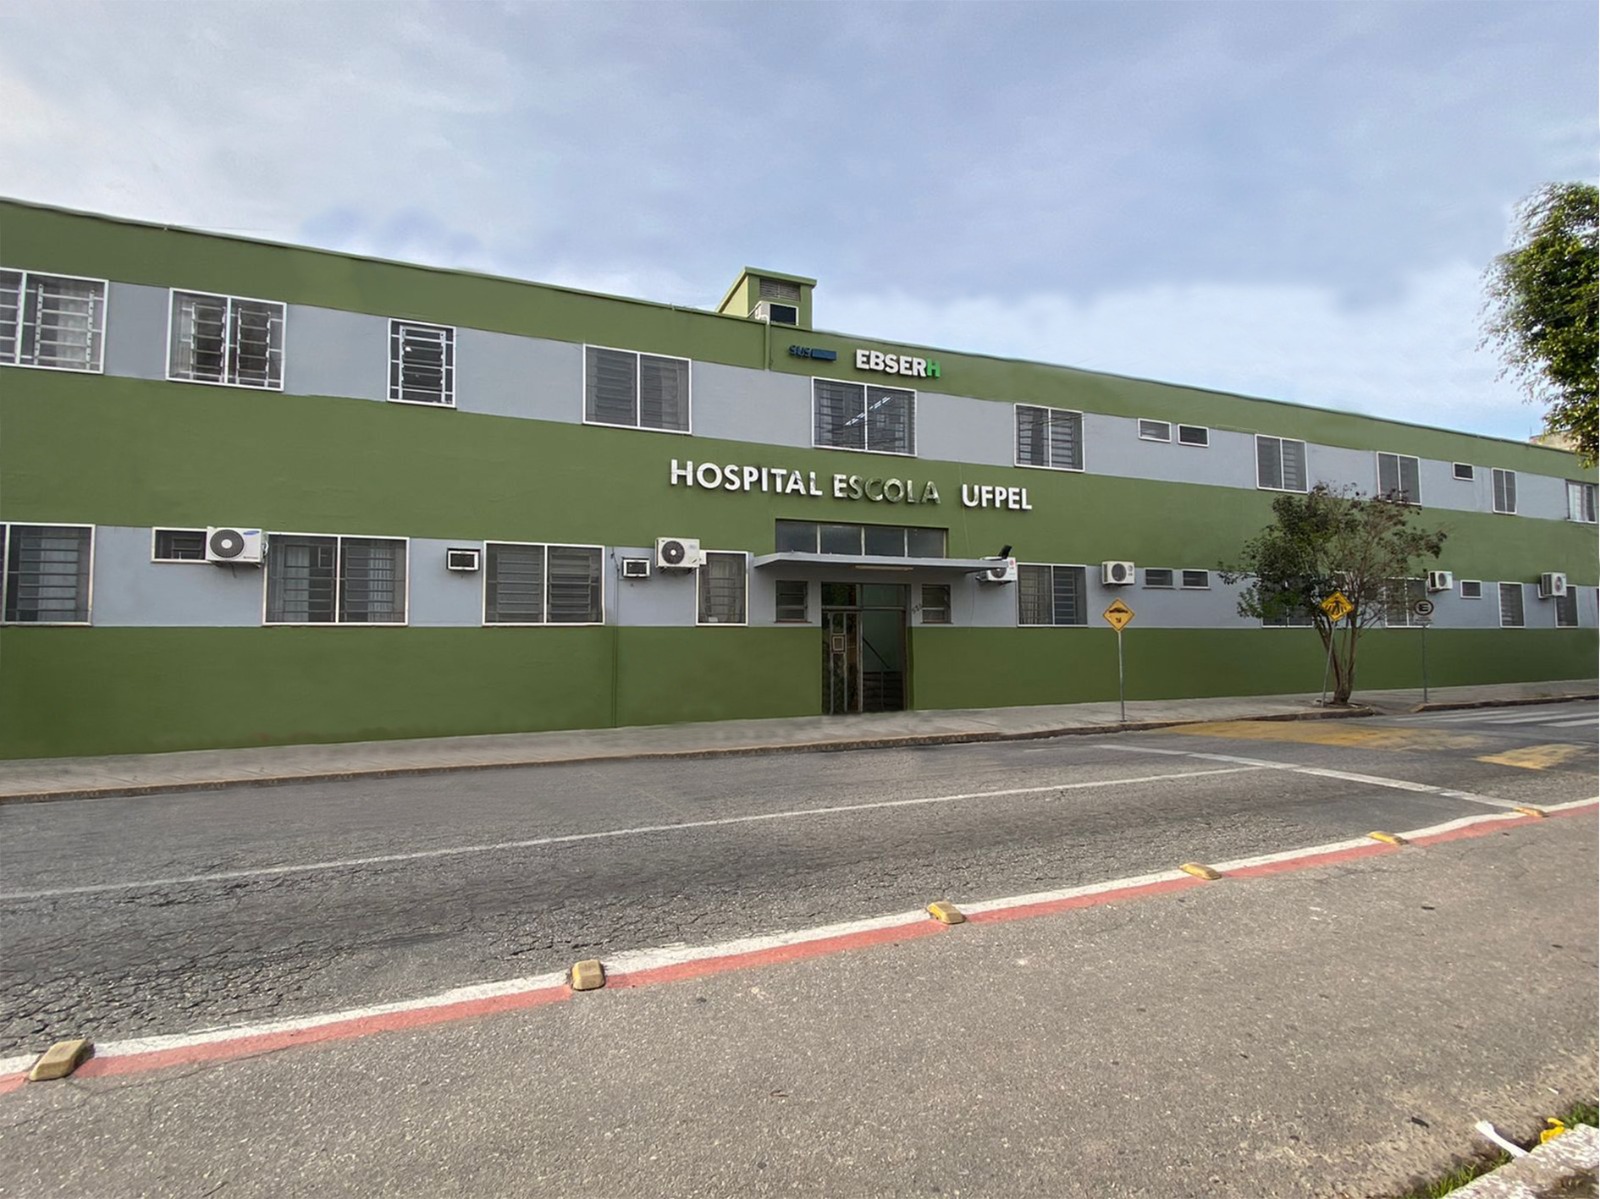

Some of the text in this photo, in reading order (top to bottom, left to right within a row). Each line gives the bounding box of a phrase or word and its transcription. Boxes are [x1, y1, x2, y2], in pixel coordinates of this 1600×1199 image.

[856, 349, 941, 378] EBSERH
[670, 459, 1032, 510] HOSPITAL ESCOLA UFPEL
